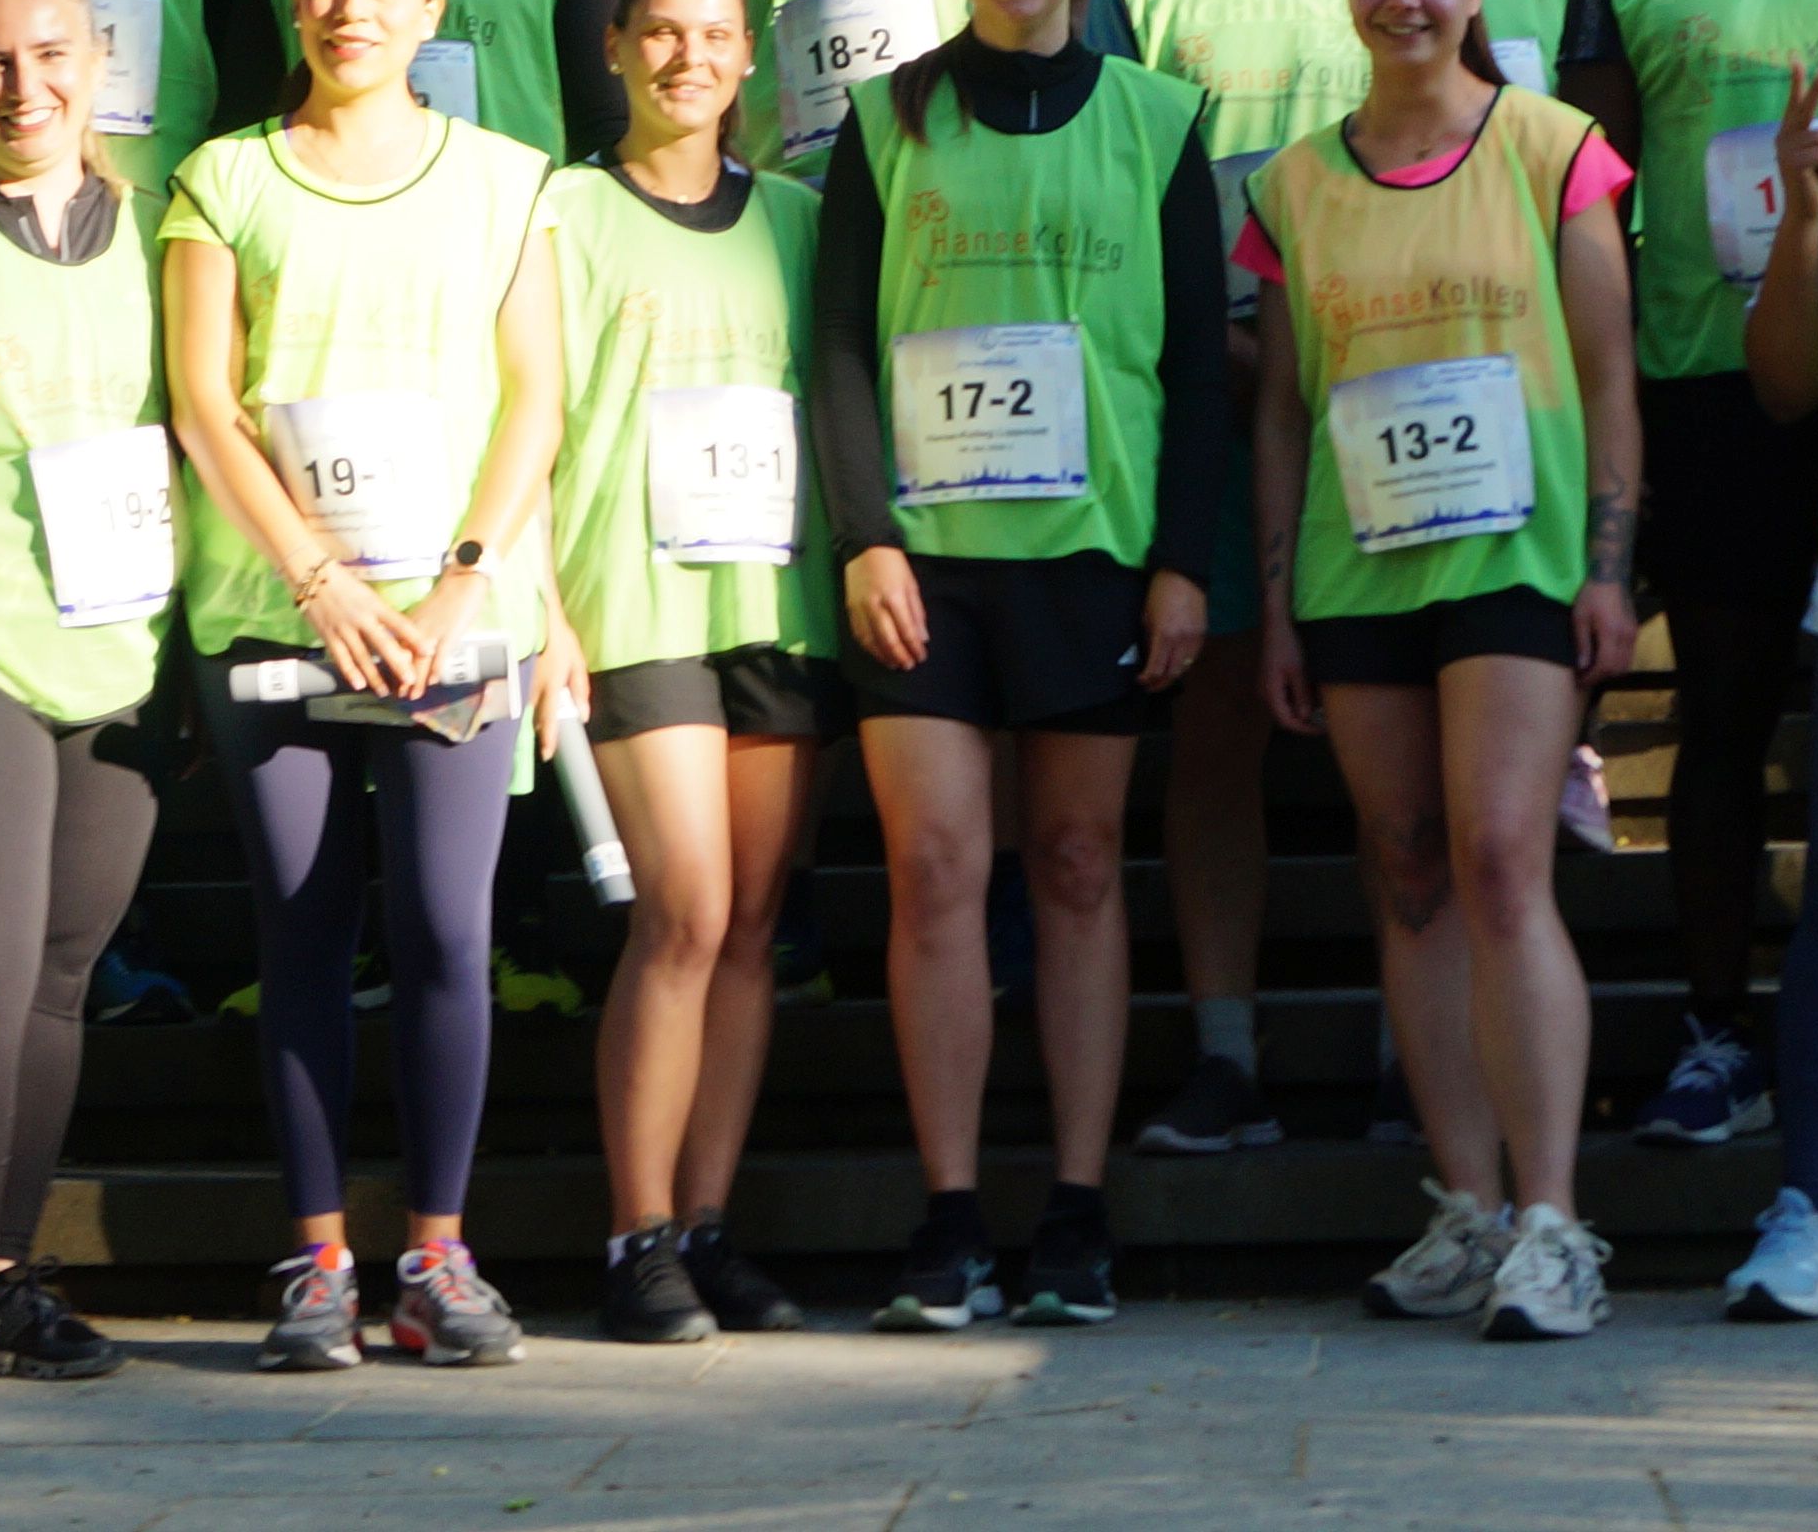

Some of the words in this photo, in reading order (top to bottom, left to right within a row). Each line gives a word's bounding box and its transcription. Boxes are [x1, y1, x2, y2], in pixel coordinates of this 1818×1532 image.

[808, 29, 895, 75] 18-2
[1333, 276, 1529, 330] HanseKolleg
[938, 378, 1035, 421] 17-2
[702, 443, 783, 482] 13-1
[1378, 415, 1480, 464] 13-2
